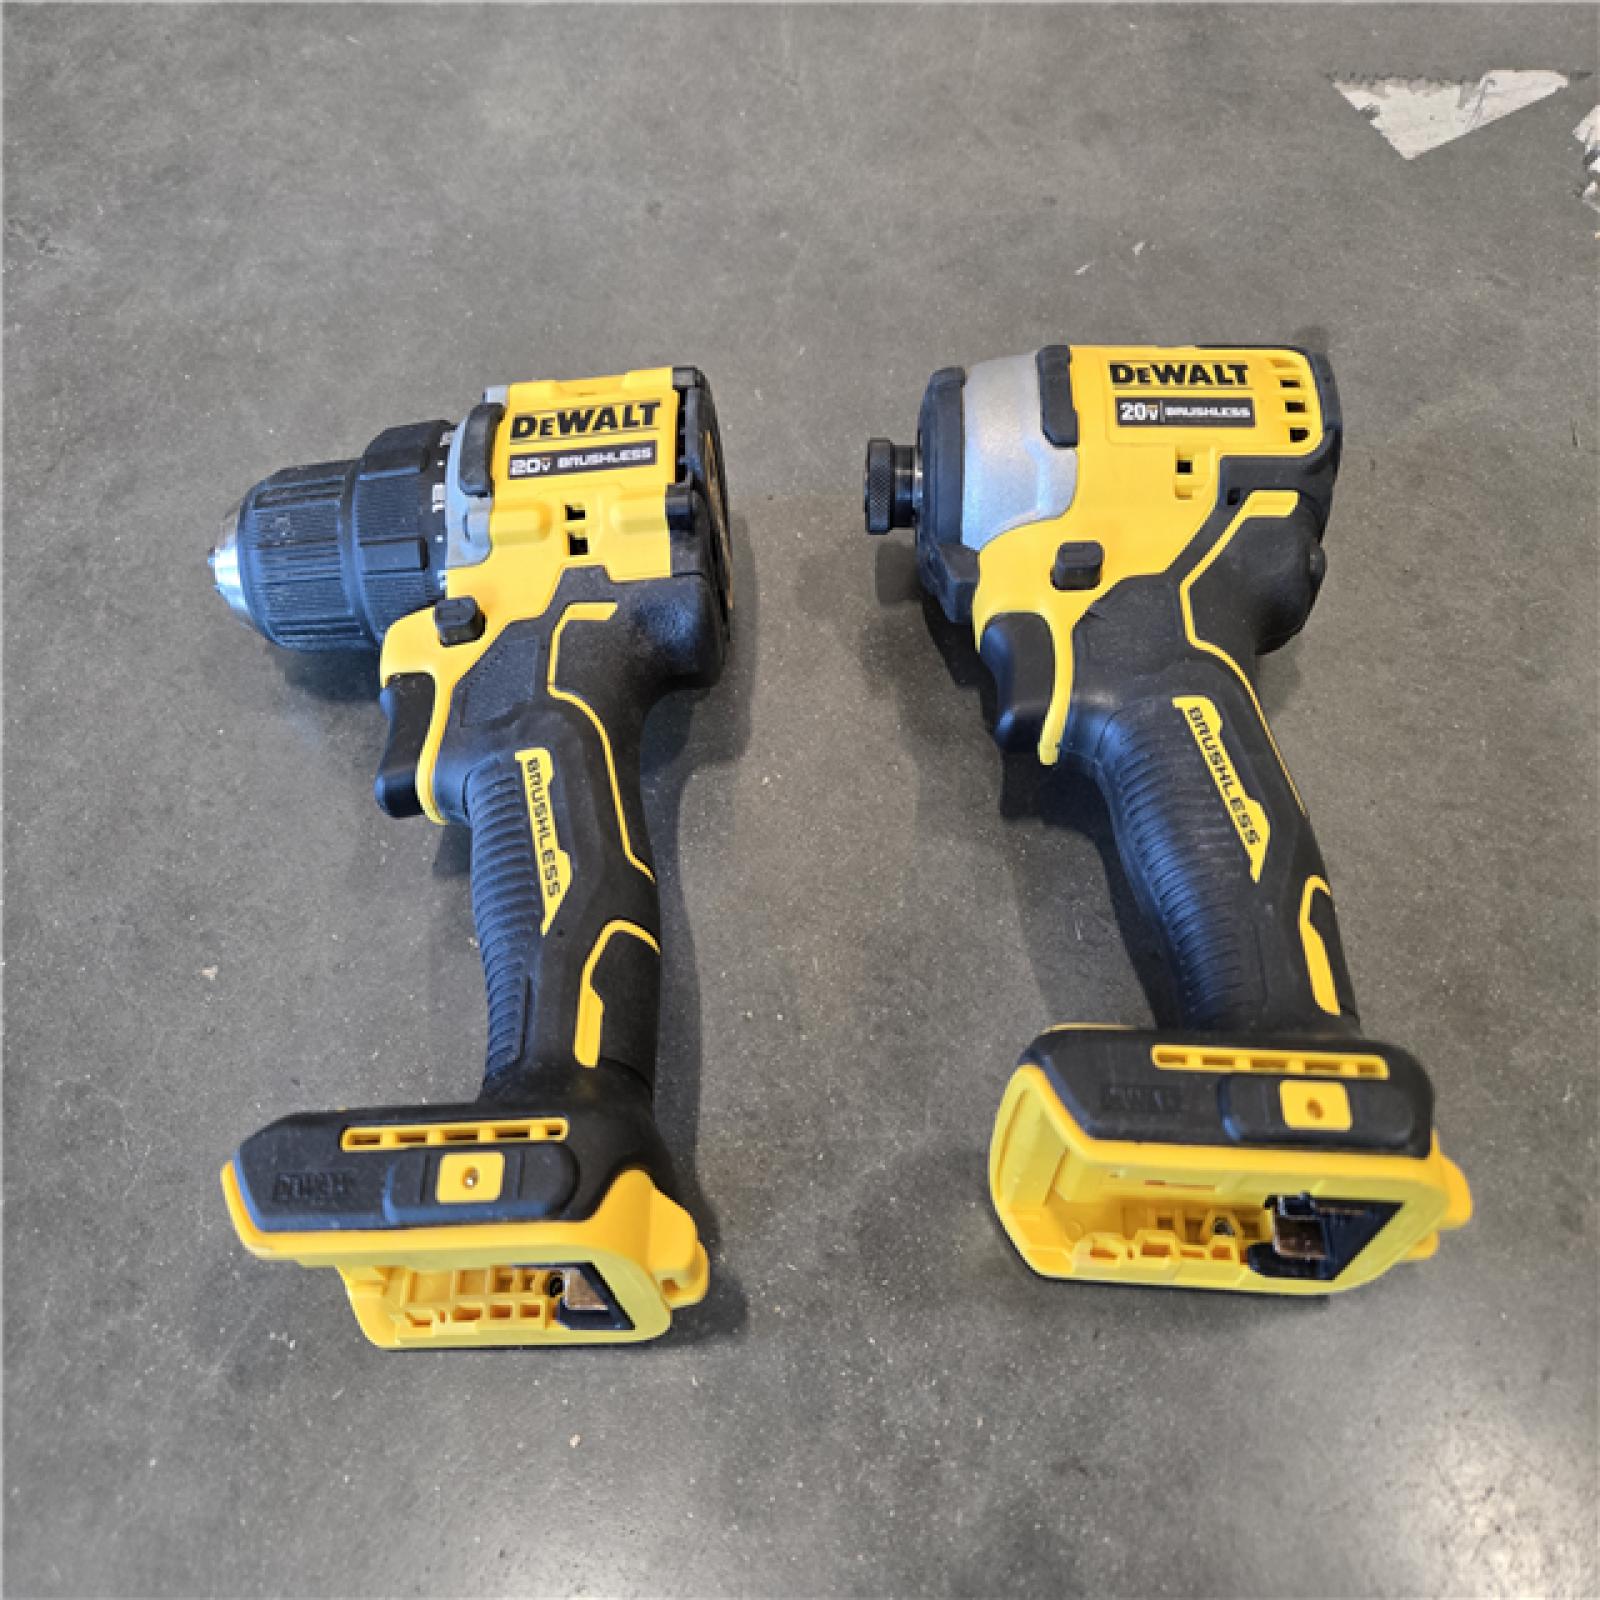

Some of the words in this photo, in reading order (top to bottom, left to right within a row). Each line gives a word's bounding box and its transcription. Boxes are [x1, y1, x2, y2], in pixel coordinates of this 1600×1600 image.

[1109, 364, 1248, 386] DEWALT
[511, 401, 661, 439] DEWALT
[1189, 706, 1261, 846] BRUSHLESS
[526, 757, 561, 898] BRUSHLESS
